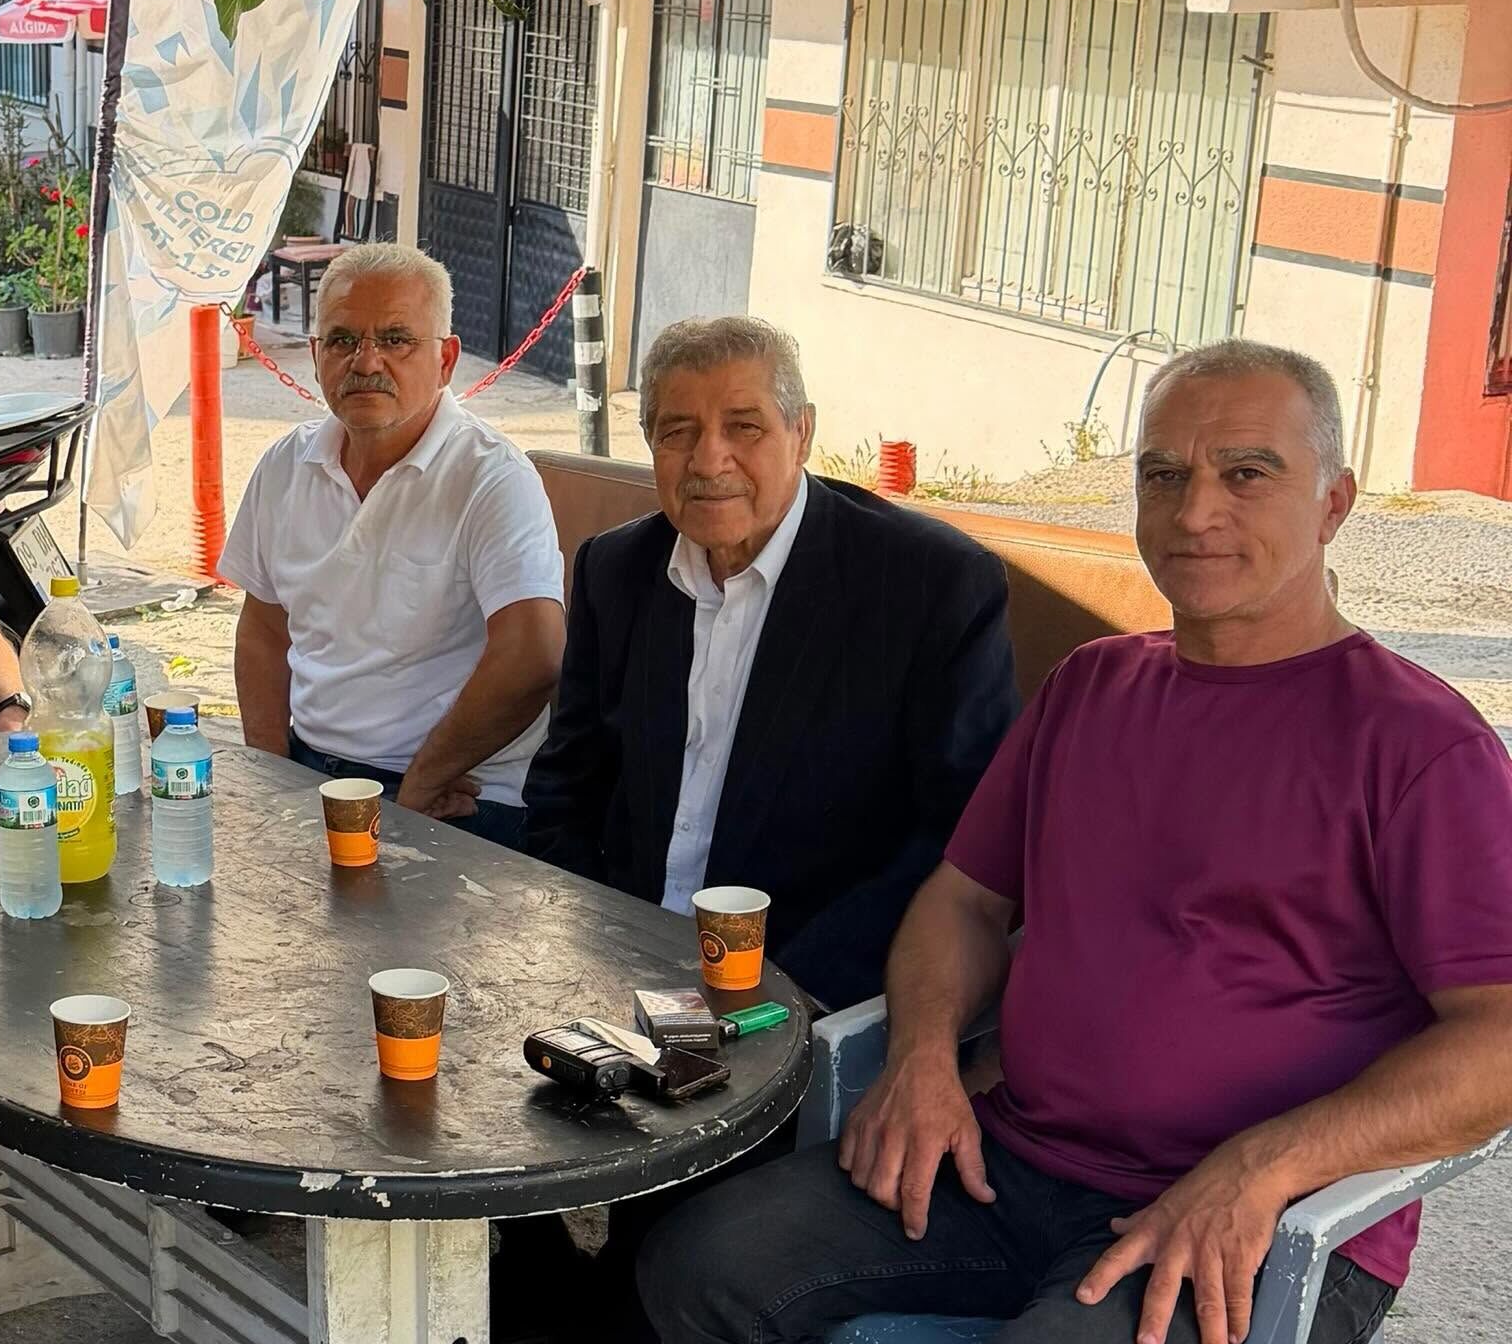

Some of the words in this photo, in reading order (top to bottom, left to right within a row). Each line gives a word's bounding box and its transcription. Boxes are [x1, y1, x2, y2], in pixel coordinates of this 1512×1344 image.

[8, 20, 57, 34] ALGIDA
[174, 190, 255, 234] COLD
[16, 541, 38, 574] 09
[56, 773, 93, 801] dağ
[56, 800, 84, 812] NATA
